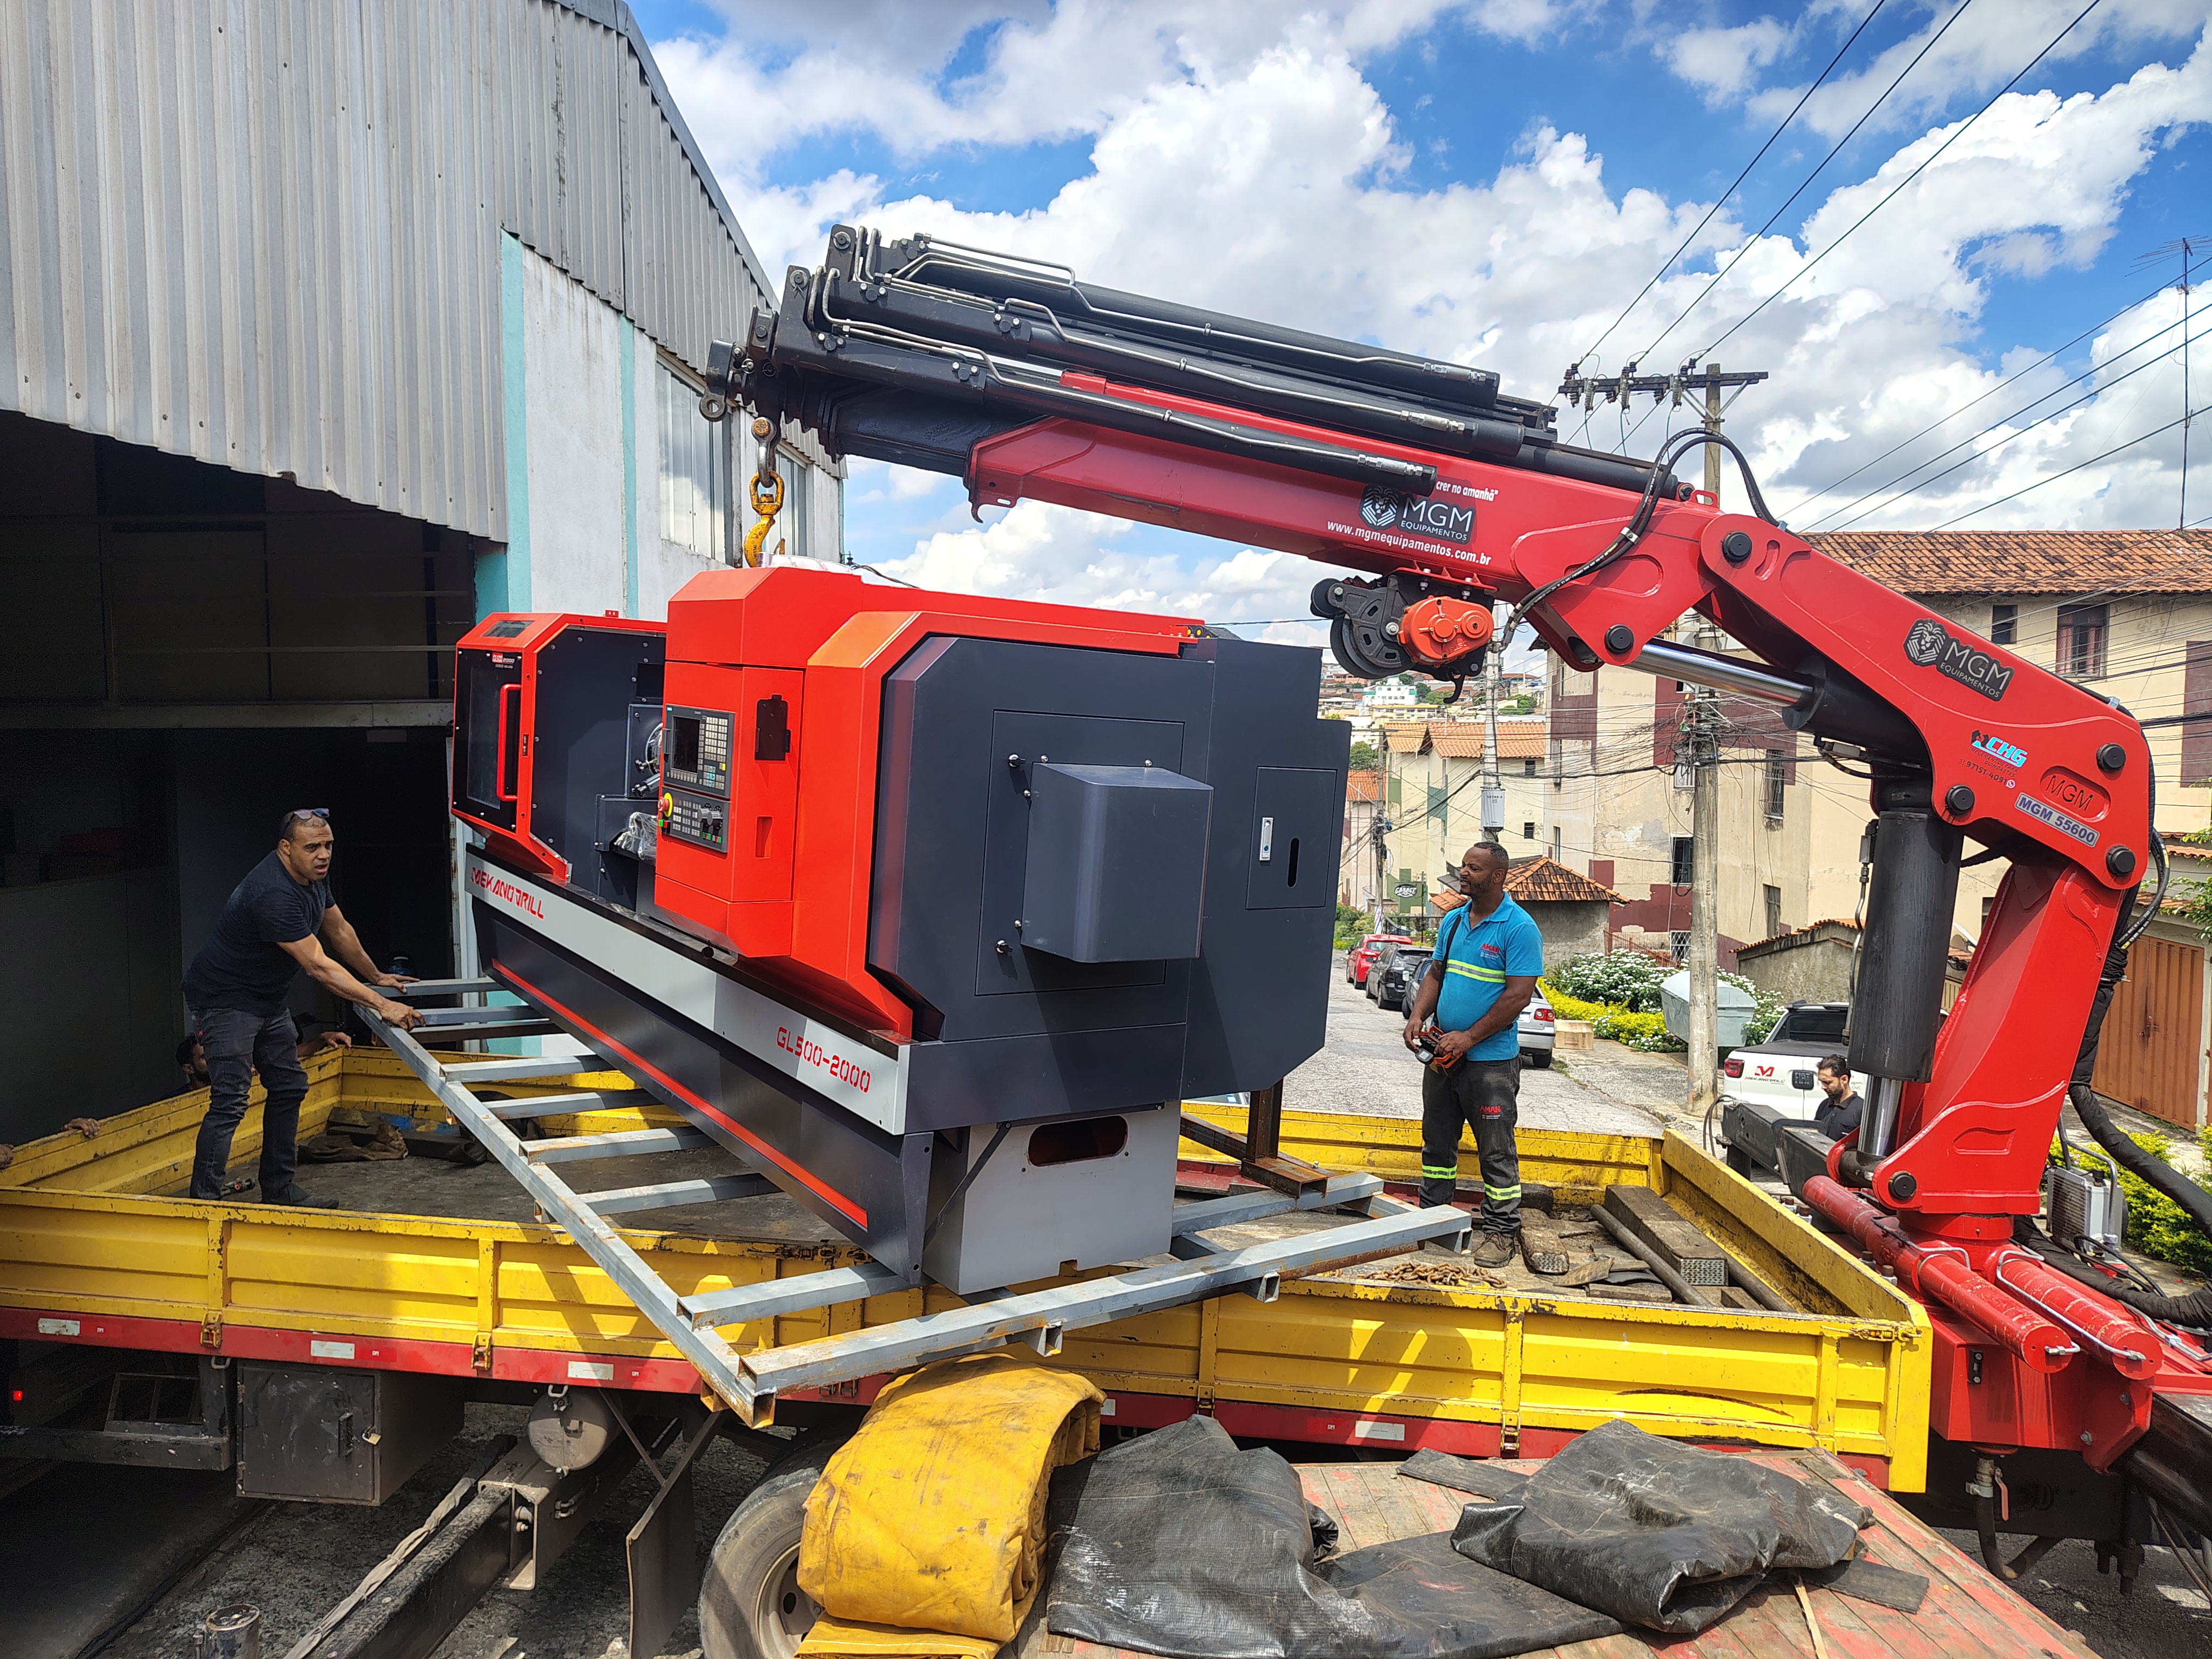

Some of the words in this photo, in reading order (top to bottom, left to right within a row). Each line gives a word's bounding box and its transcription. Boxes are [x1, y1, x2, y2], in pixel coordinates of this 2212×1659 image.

[1436, 481, 1451, 492] crer
[1452, 484, 1461, 494] no
[1462, 487, 1499, 501] amanhã"
[1401, 520, 1467, 541] EQUIPAMENTOS
[1403, 497, 1473, 532] MGM
[1327, 521, 1492, 565] www.mgmequipamentos.com.br
[1940, 662, 2000, 698] EQUIPAMENTOS
[1944, 641, 2011, 690] MGM
[1986, 737, 2028, 767] CHG
[1966, 760, 2007, 785] 97151-4091
[2045, 775, 2094, 811] MGM
[2019, 797, 2053, 821] MGM
[2054, 815, 2095, 842] 55600
[471, 867, 544, 920] MEKANODRILL
[777, 1027, 871, 1093] GL500-2000
